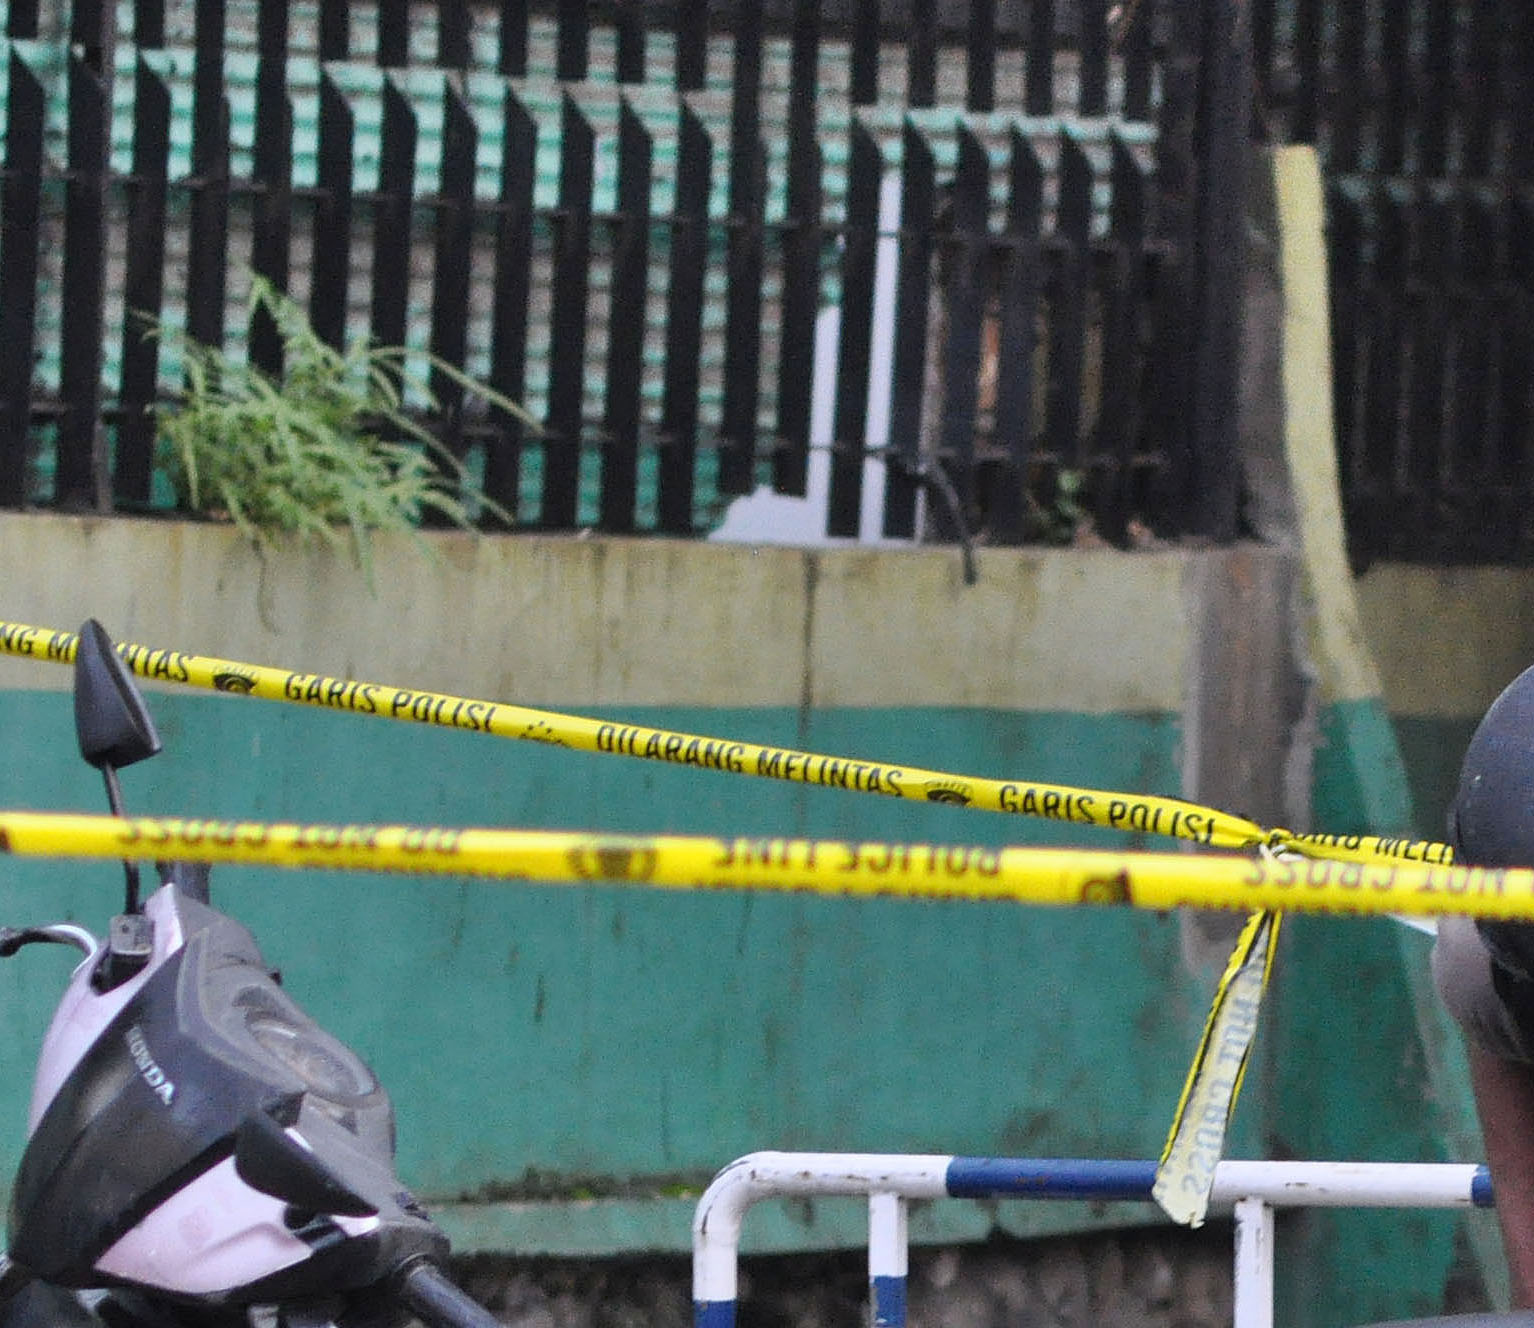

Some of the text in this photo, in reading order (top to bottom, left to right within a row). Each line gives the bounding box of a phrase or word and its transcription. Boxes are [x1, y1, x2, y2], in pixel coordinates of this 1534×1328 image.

[284, 673, 496, 732] GARIS POLISI
[595, 724, 903, 797] DILARANG MELINTAS
[1000, 784, 1096, 825] GARIS
[1108, 799, 1216, 845] POLISI
[126, 1025, 174, 1105] HONDA
